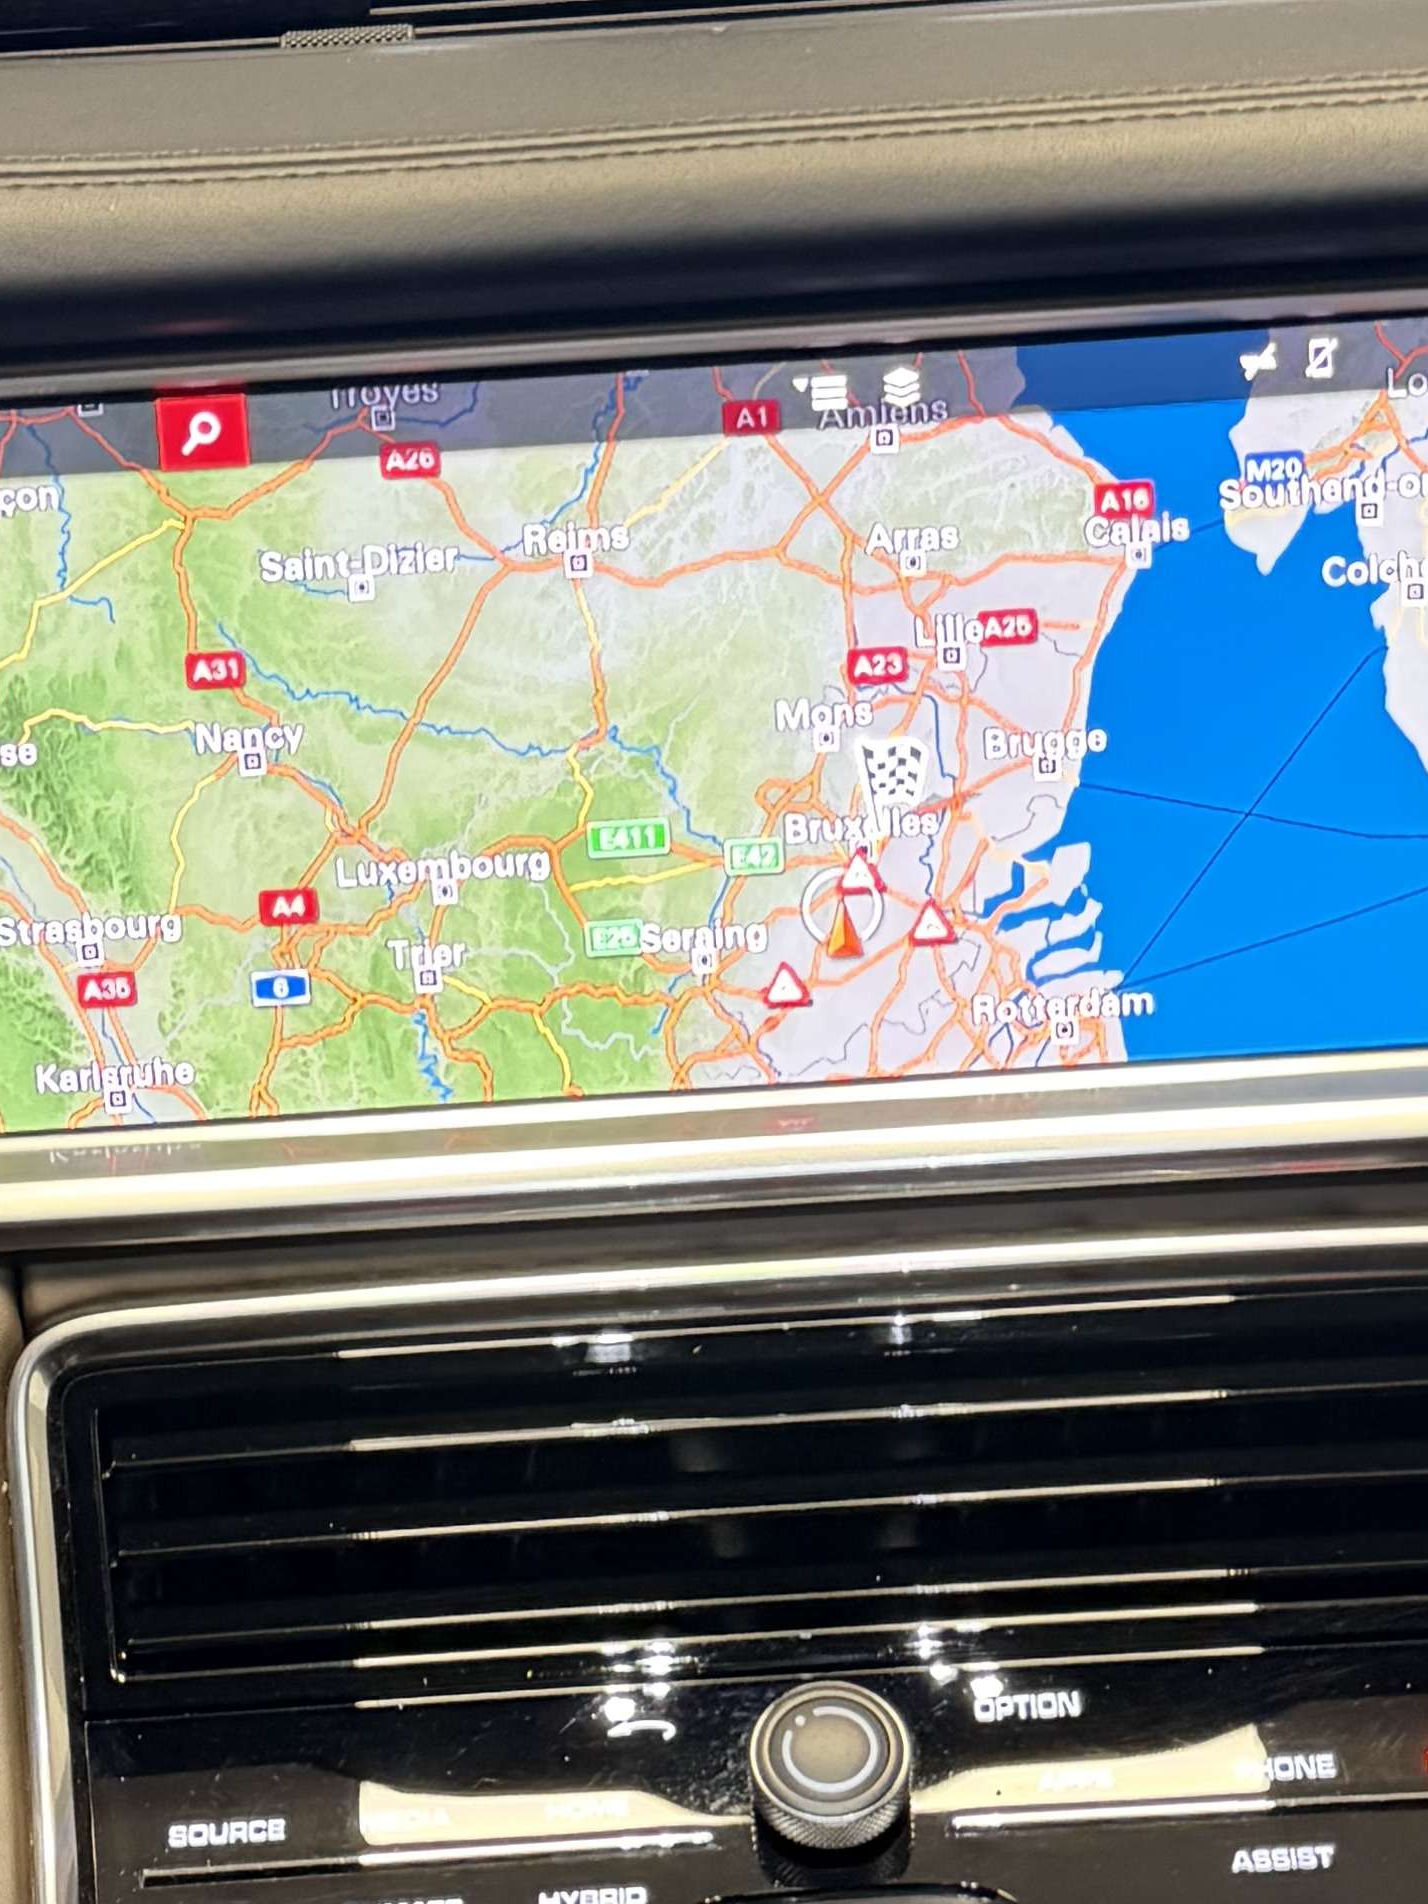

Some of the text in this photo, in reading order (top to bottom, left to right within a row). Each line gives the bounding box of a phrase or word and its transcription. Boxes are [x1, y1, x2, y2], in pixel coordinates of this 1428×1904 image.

[737, 405, 769, 427] A1
[820, 398, 948, 430] Amiens
[1246, 456, 1301, 482] M20
[522, 522, 630, 556] Reims
[865, 523, 959, 556] Arras
[1084, 512, 1190, 548] Calais
[260, 541, 459, 583] Saint-Dizier
[192, 659, 239, 681] A31
[853, 652, 902, 677] A23
[775, 699, 873, 733] Mons
[195, 721, 304, 755] Nancy
[983, 724, 1107, 761] Brugge
[336, 850, 551, 888] Luxembourg
[273, 895, 304, 917] A4
[388, 939, 466, 971] Trier
[971, 989, 1155, 1027] Rotterdam
[36, 1058, 196, 1094] Karlsruhe
[974, 1692, 1081, 1721] OPTION
[169, 1819, 286, 1848] SOURCE
[1232, 1845, 1334, 1873] ASSIST
